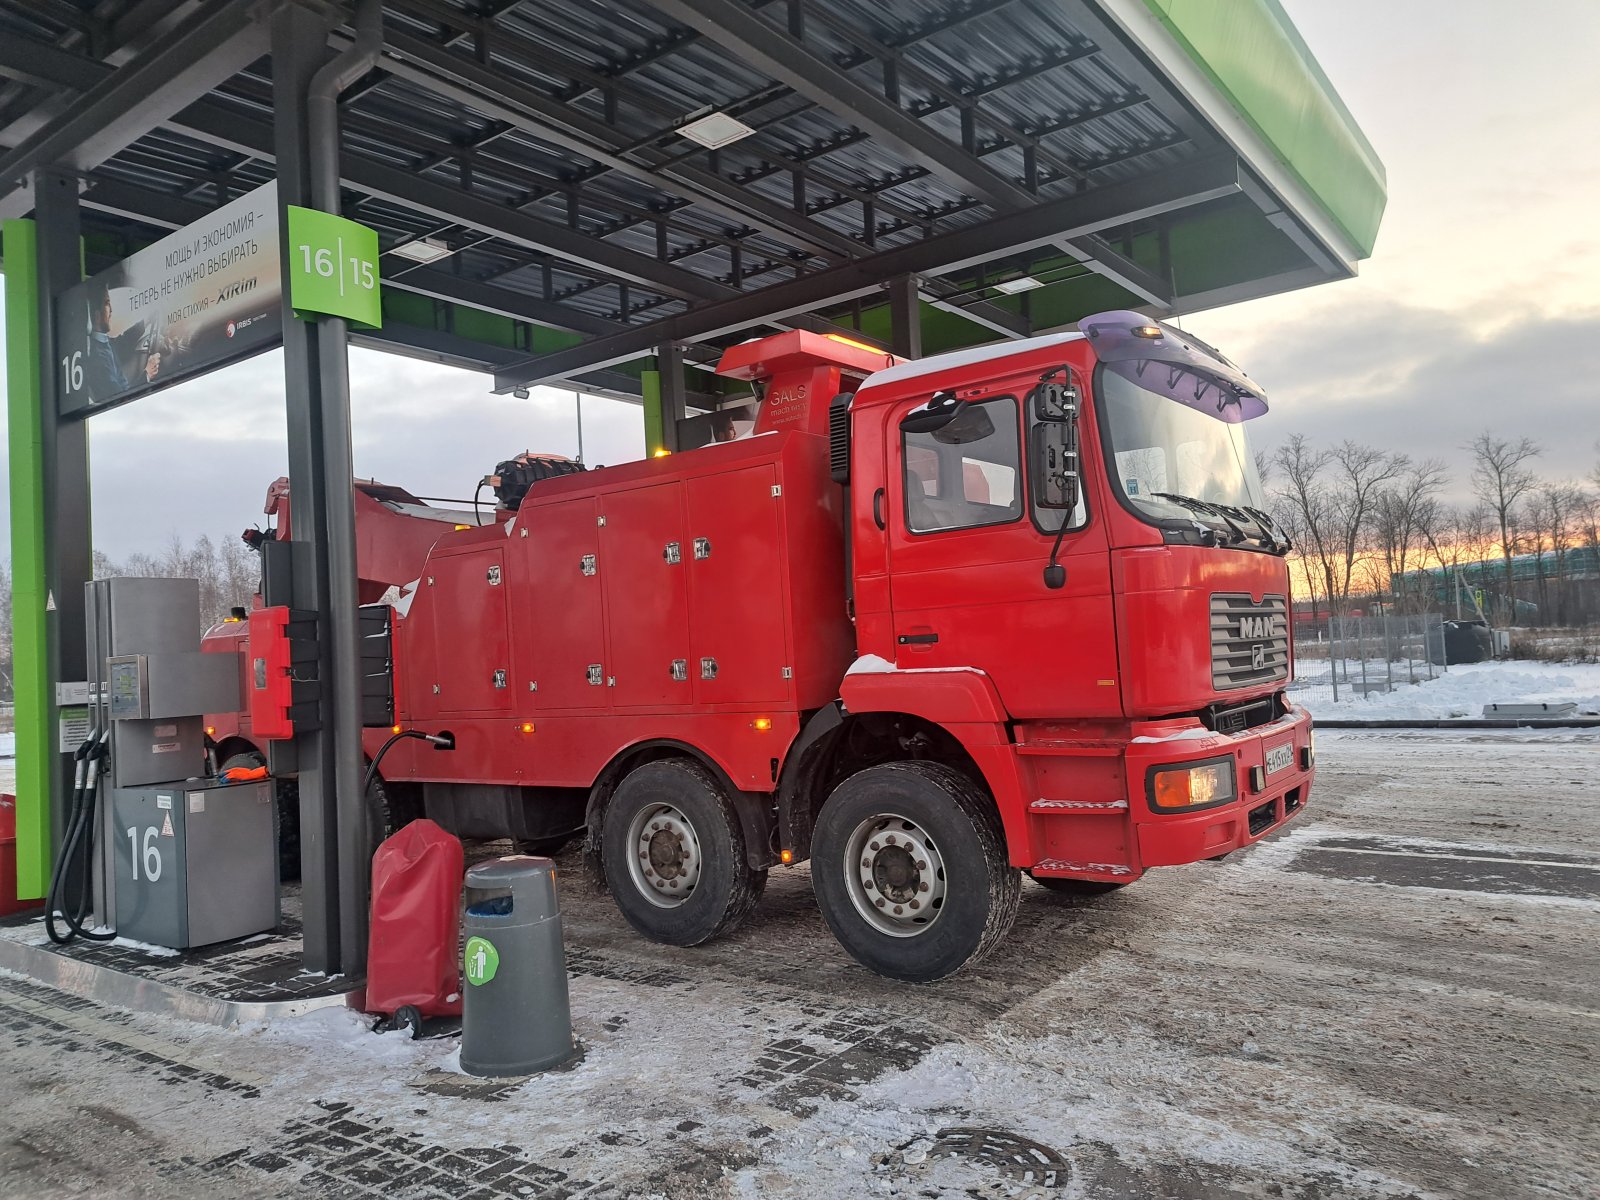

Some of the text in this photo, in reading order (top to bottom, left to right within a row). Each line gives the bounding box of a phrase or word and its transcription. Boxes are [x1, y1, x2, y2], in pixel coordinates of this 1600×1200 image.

[165, 245, 193, 270] МОЩЬ
[193, 239, 200, 257] И
[202, 211, 254, 252] ЭКОНОМИЯ
[129, 239, 258, 312] ТЕПЕРЬ НЕ НУЖНО ВЫБИРАТЬ
[299, 245, 374, 290] 16 15
[167, 309, 182, 325] МОЯ
[182, 297, 209, 318] СТИХИЯ
[236, 317, 252, 330] IRBIS
[62, 350, 83, 394] 16
[770, 384, 806, 406] GALS
[1240, 616, 1274, 639] MAN
[127, 826, 162, 882] 16
